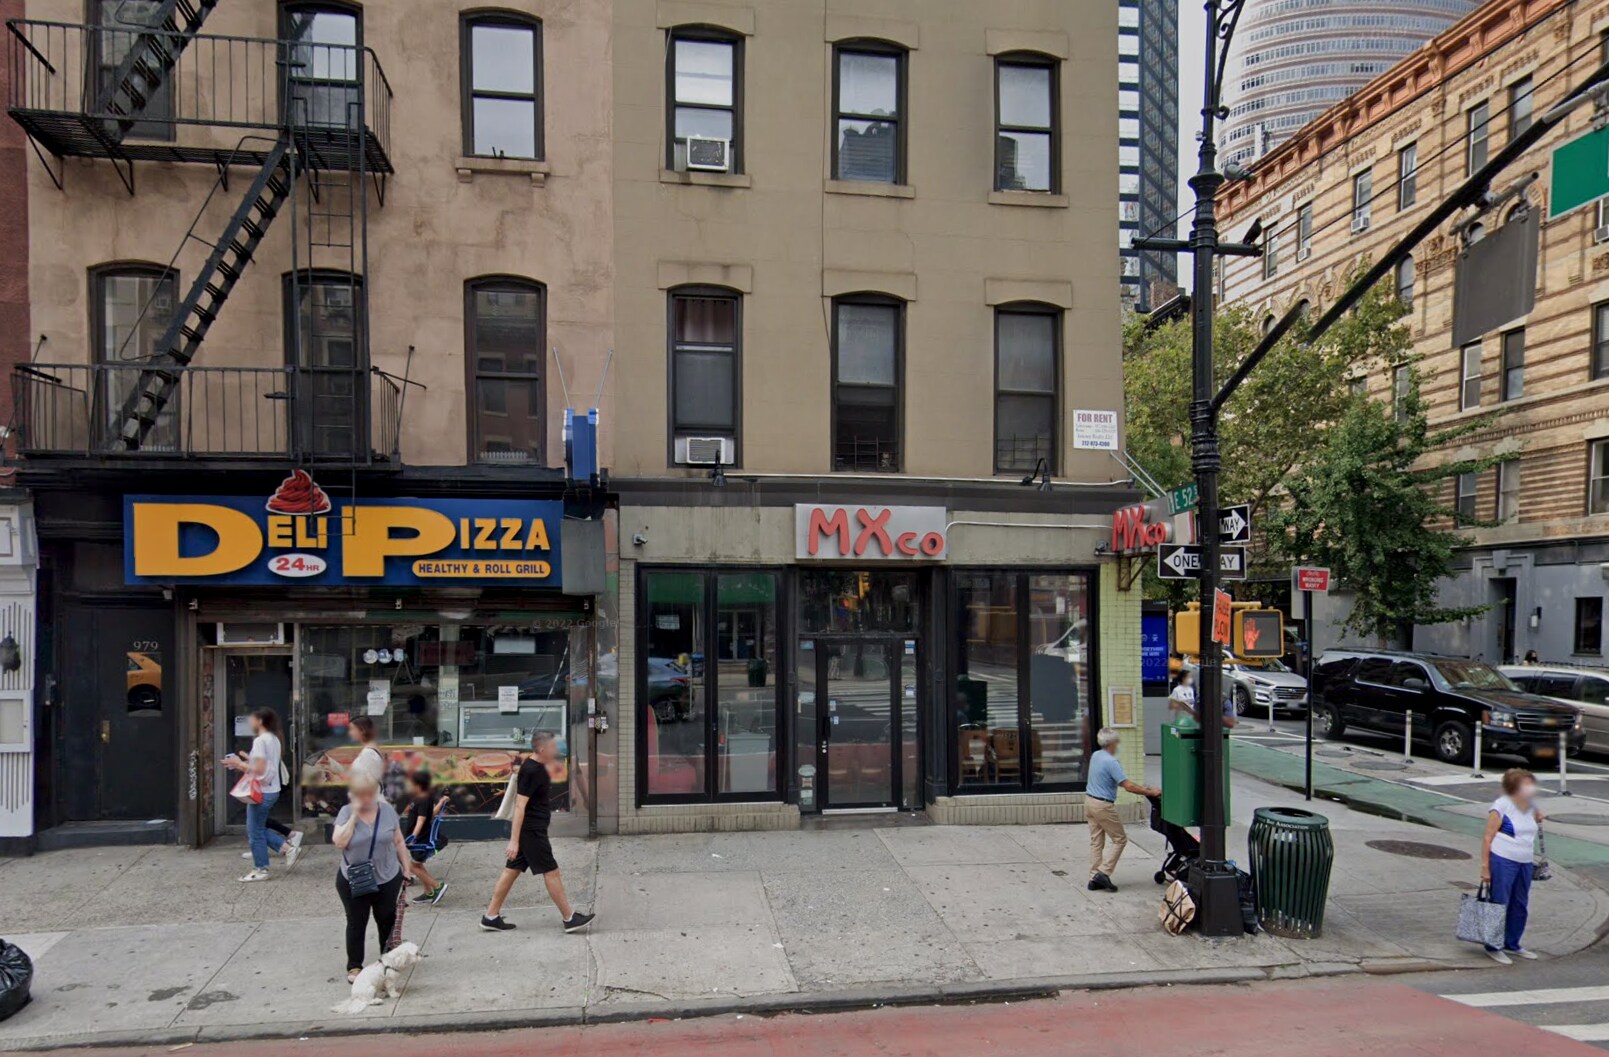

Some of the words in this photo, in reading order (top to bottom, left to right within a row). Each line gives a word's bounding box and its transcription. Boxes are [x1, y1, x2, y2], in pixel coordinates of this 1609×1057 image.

[1077, 413, 1092, 422] FOR
[1093, 414, 1113, 423] RENT
[1174, 491, 1181, 510] E
[1182, 487, 1193, 507] 52
[1223, 518, 1240, 532] WAY
[133, 502, 328, 577] DELI
[341, 505, 551, 577] PIZZA
[1173, 555, 1198, 568] ONE
[419, 564, 468, 574] HEALTHY
[473, 564, 480, 574] &
[485, 564, 511, 574] ROLL
[516, 564, 545, 574] GRILL
[133, 640, 159, 652] 979
